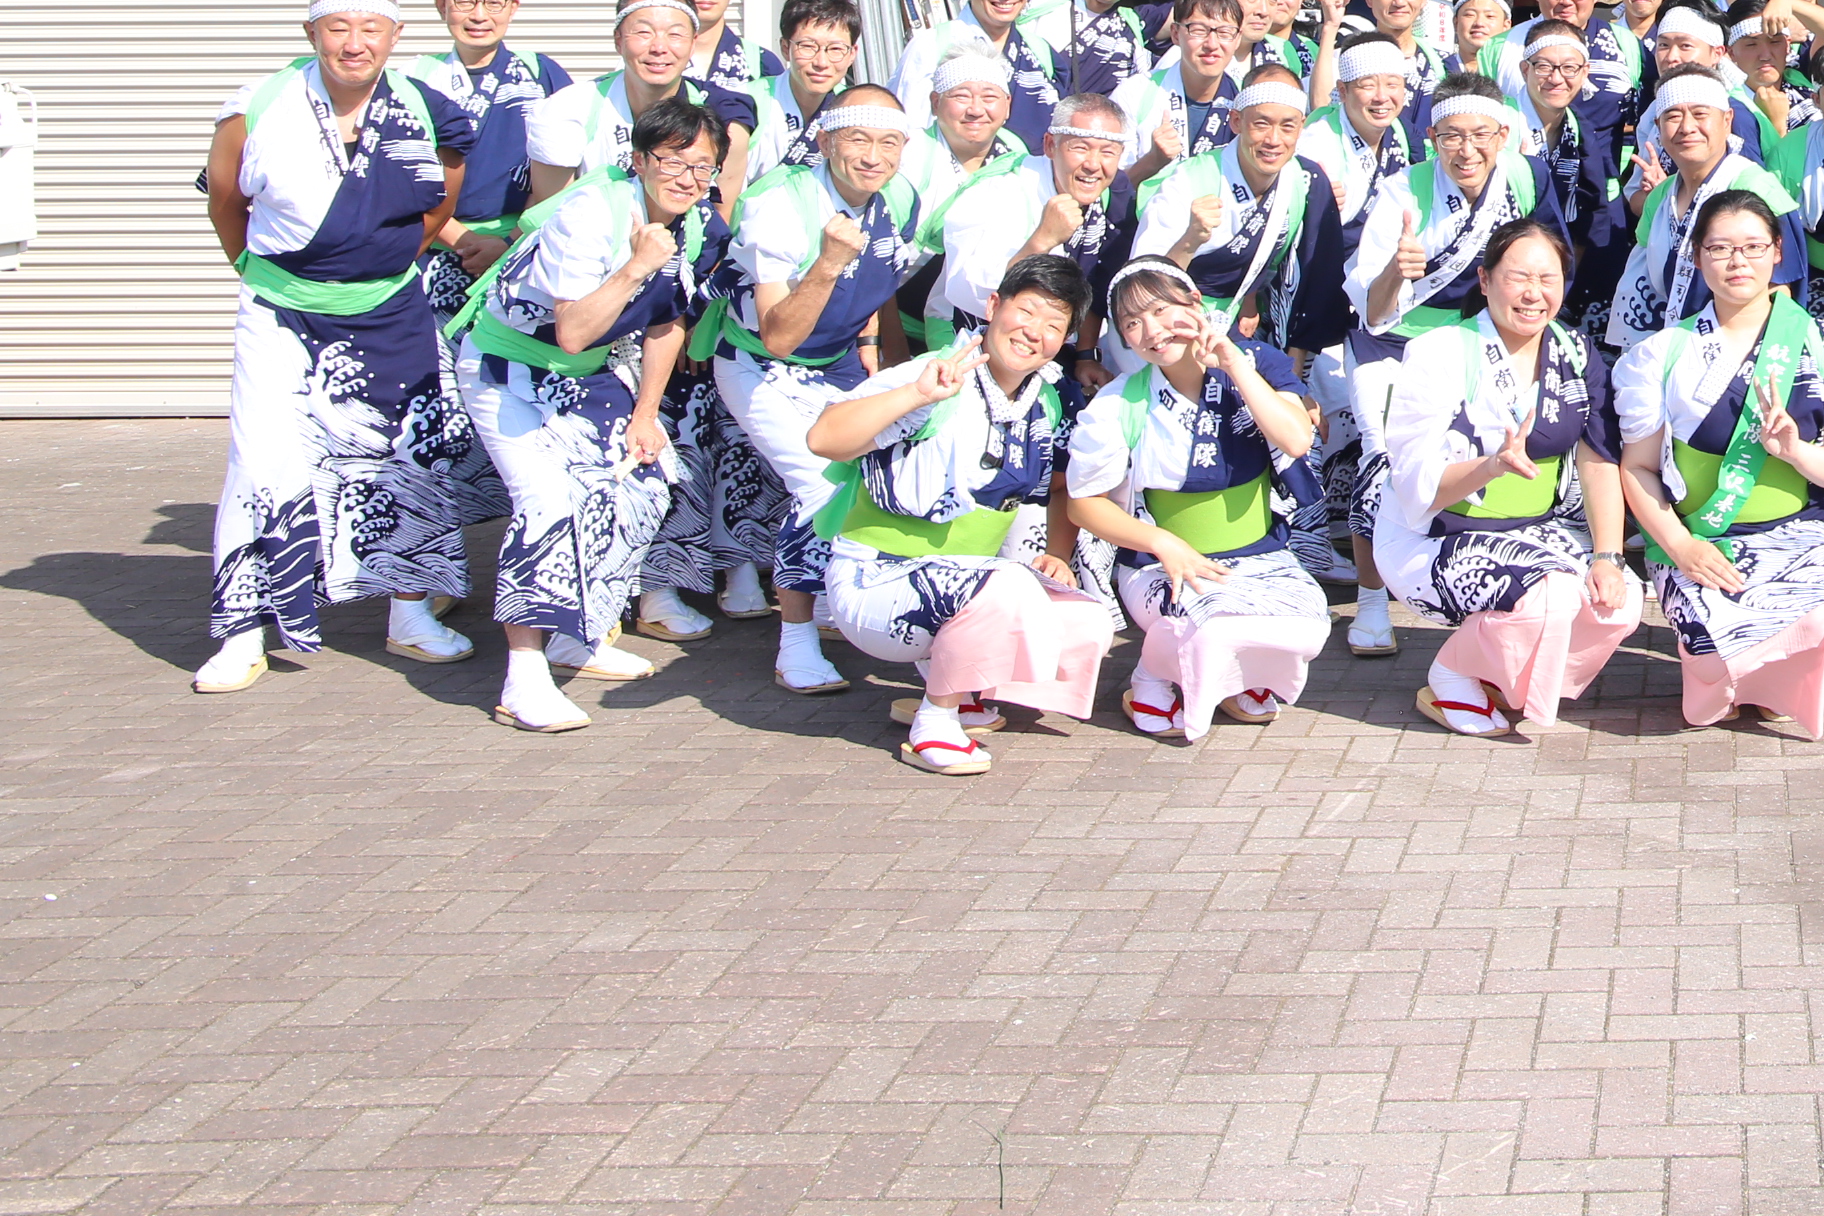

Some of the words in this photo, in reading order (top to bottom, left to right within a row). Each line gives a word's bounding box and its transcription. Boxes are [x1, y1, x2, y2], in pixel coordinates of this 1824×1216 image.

[350, 97, 389, 178] 自衛隊
[1541, 338, 1562, 424] 自衛隊
[1192, 380, 1224, 468] 自衛隊
[1701, 453, 1752, 528] 三沢基地
